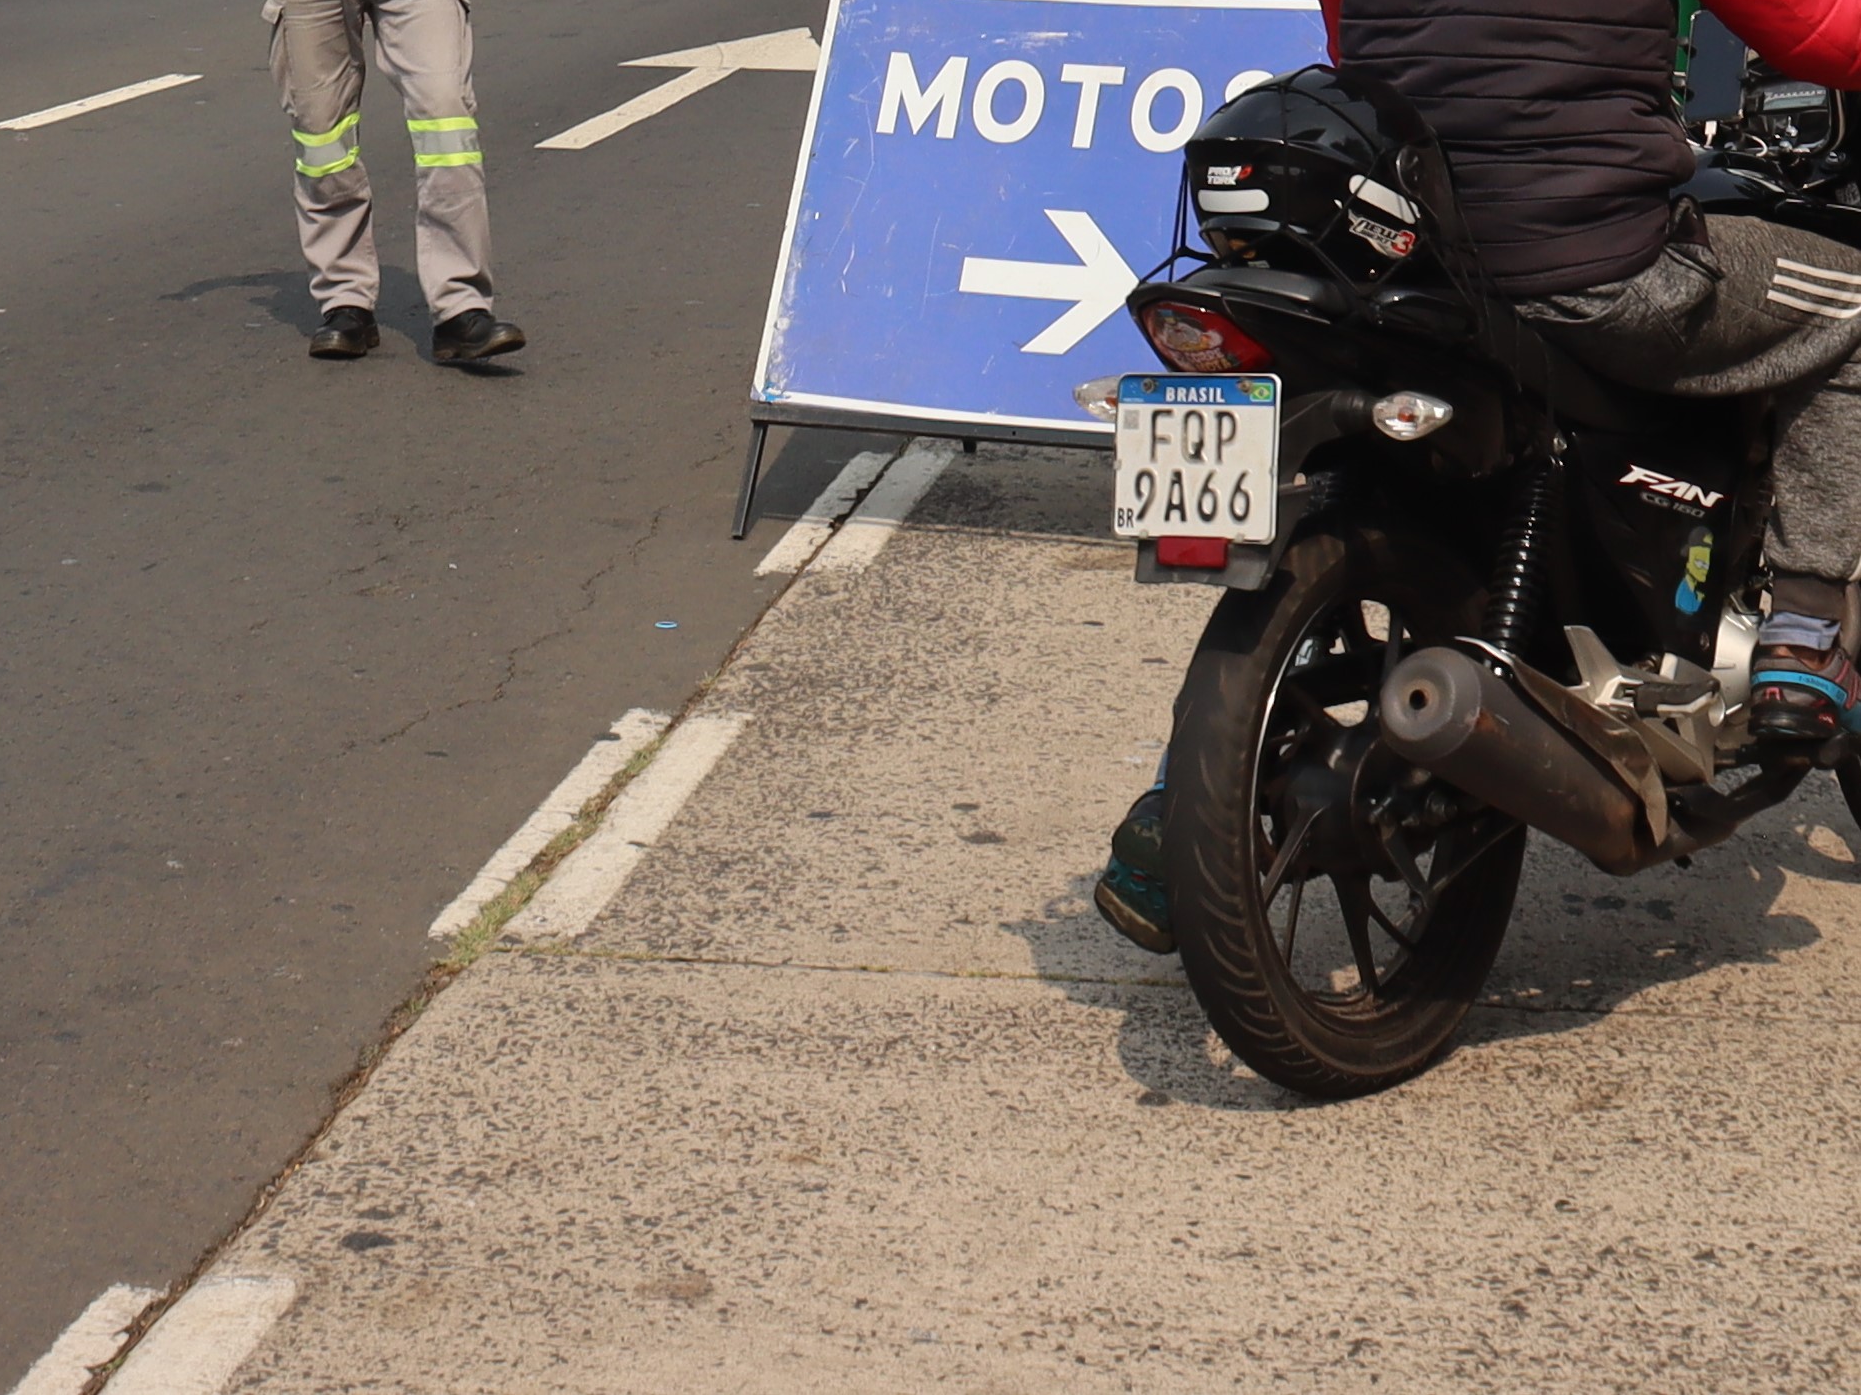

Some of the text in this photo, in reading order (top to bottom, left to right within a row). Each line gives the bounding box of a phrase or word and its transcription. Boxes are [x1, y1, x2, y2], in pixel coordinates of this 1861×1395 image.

[1165, 387, 1226, 403] BRASIL
[1150, 408, 1238, 464] FQP
[1135, 468, 1252, 523] 9A66
[1619, 464, 1725, 508] FAN
[1640, 491, 1670, 507] CG
[1117, 508, 1135, 528] BR
